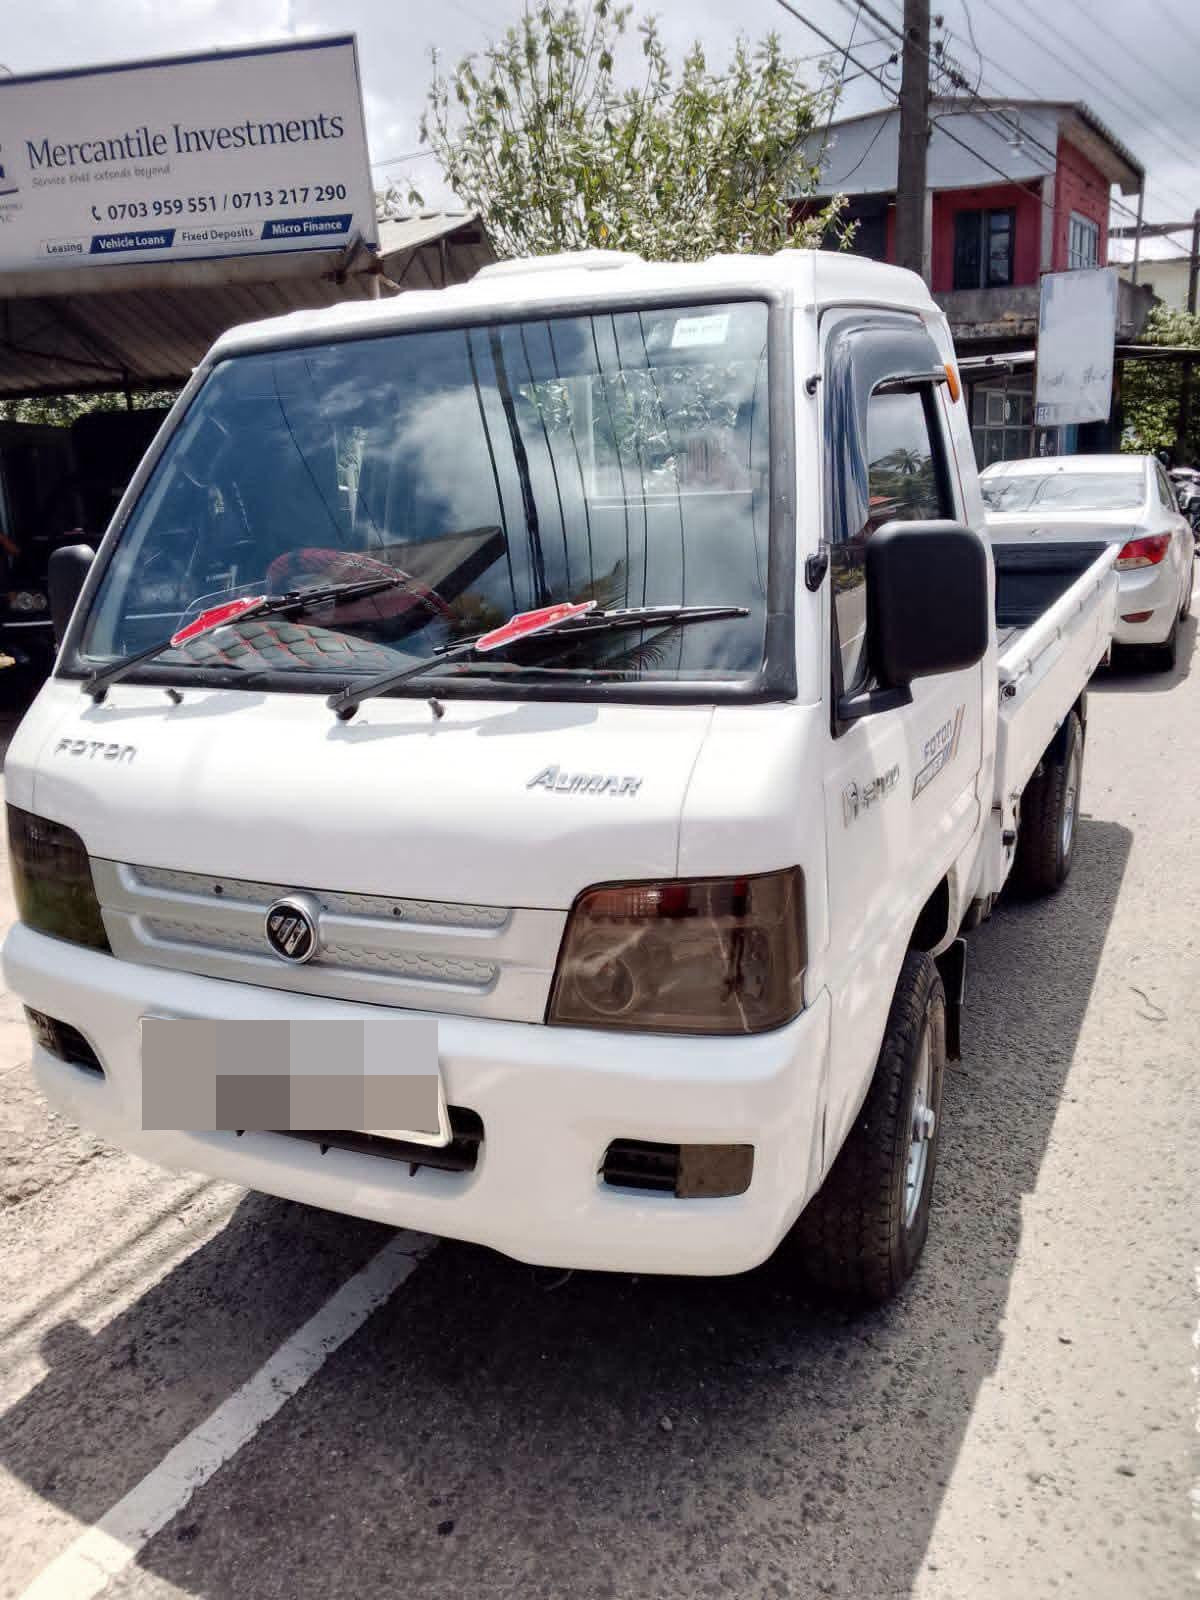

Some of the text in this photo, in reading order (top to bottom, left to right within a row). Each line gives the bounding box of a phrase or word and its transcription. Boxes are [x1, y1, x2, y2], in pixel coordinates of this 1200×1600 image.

[26, 113, 345, 170] Mercantile Investments
[134, 163, 171, 178] beyond
[108, 184, 346, 220] 0703 959 551 / 0713 217 290
[46, 220, 343, 254] Leasing Vehicle Loans Fixed Deposits Micro Finance
